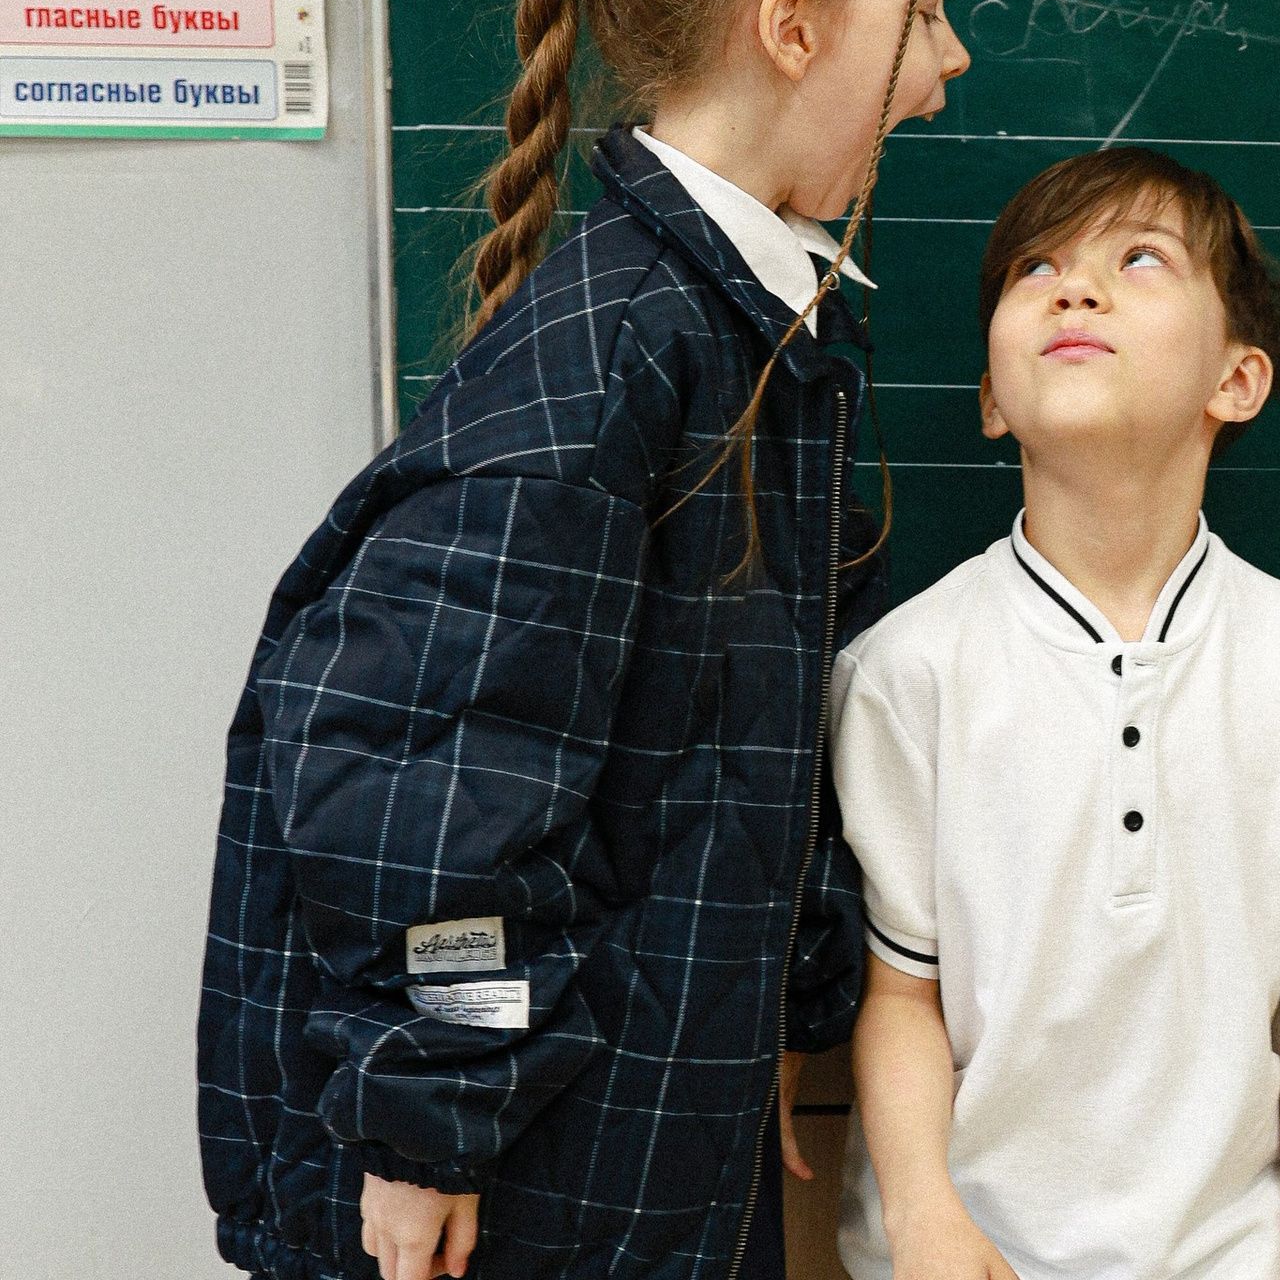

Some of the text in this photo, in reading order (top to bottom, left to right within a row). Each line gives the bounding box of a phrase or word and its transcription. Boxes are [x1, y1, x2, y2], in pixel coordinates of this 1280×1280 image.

[23, 4, 240, 35] гласные буквы
[15, 79, 260, 108] согласные буквы
